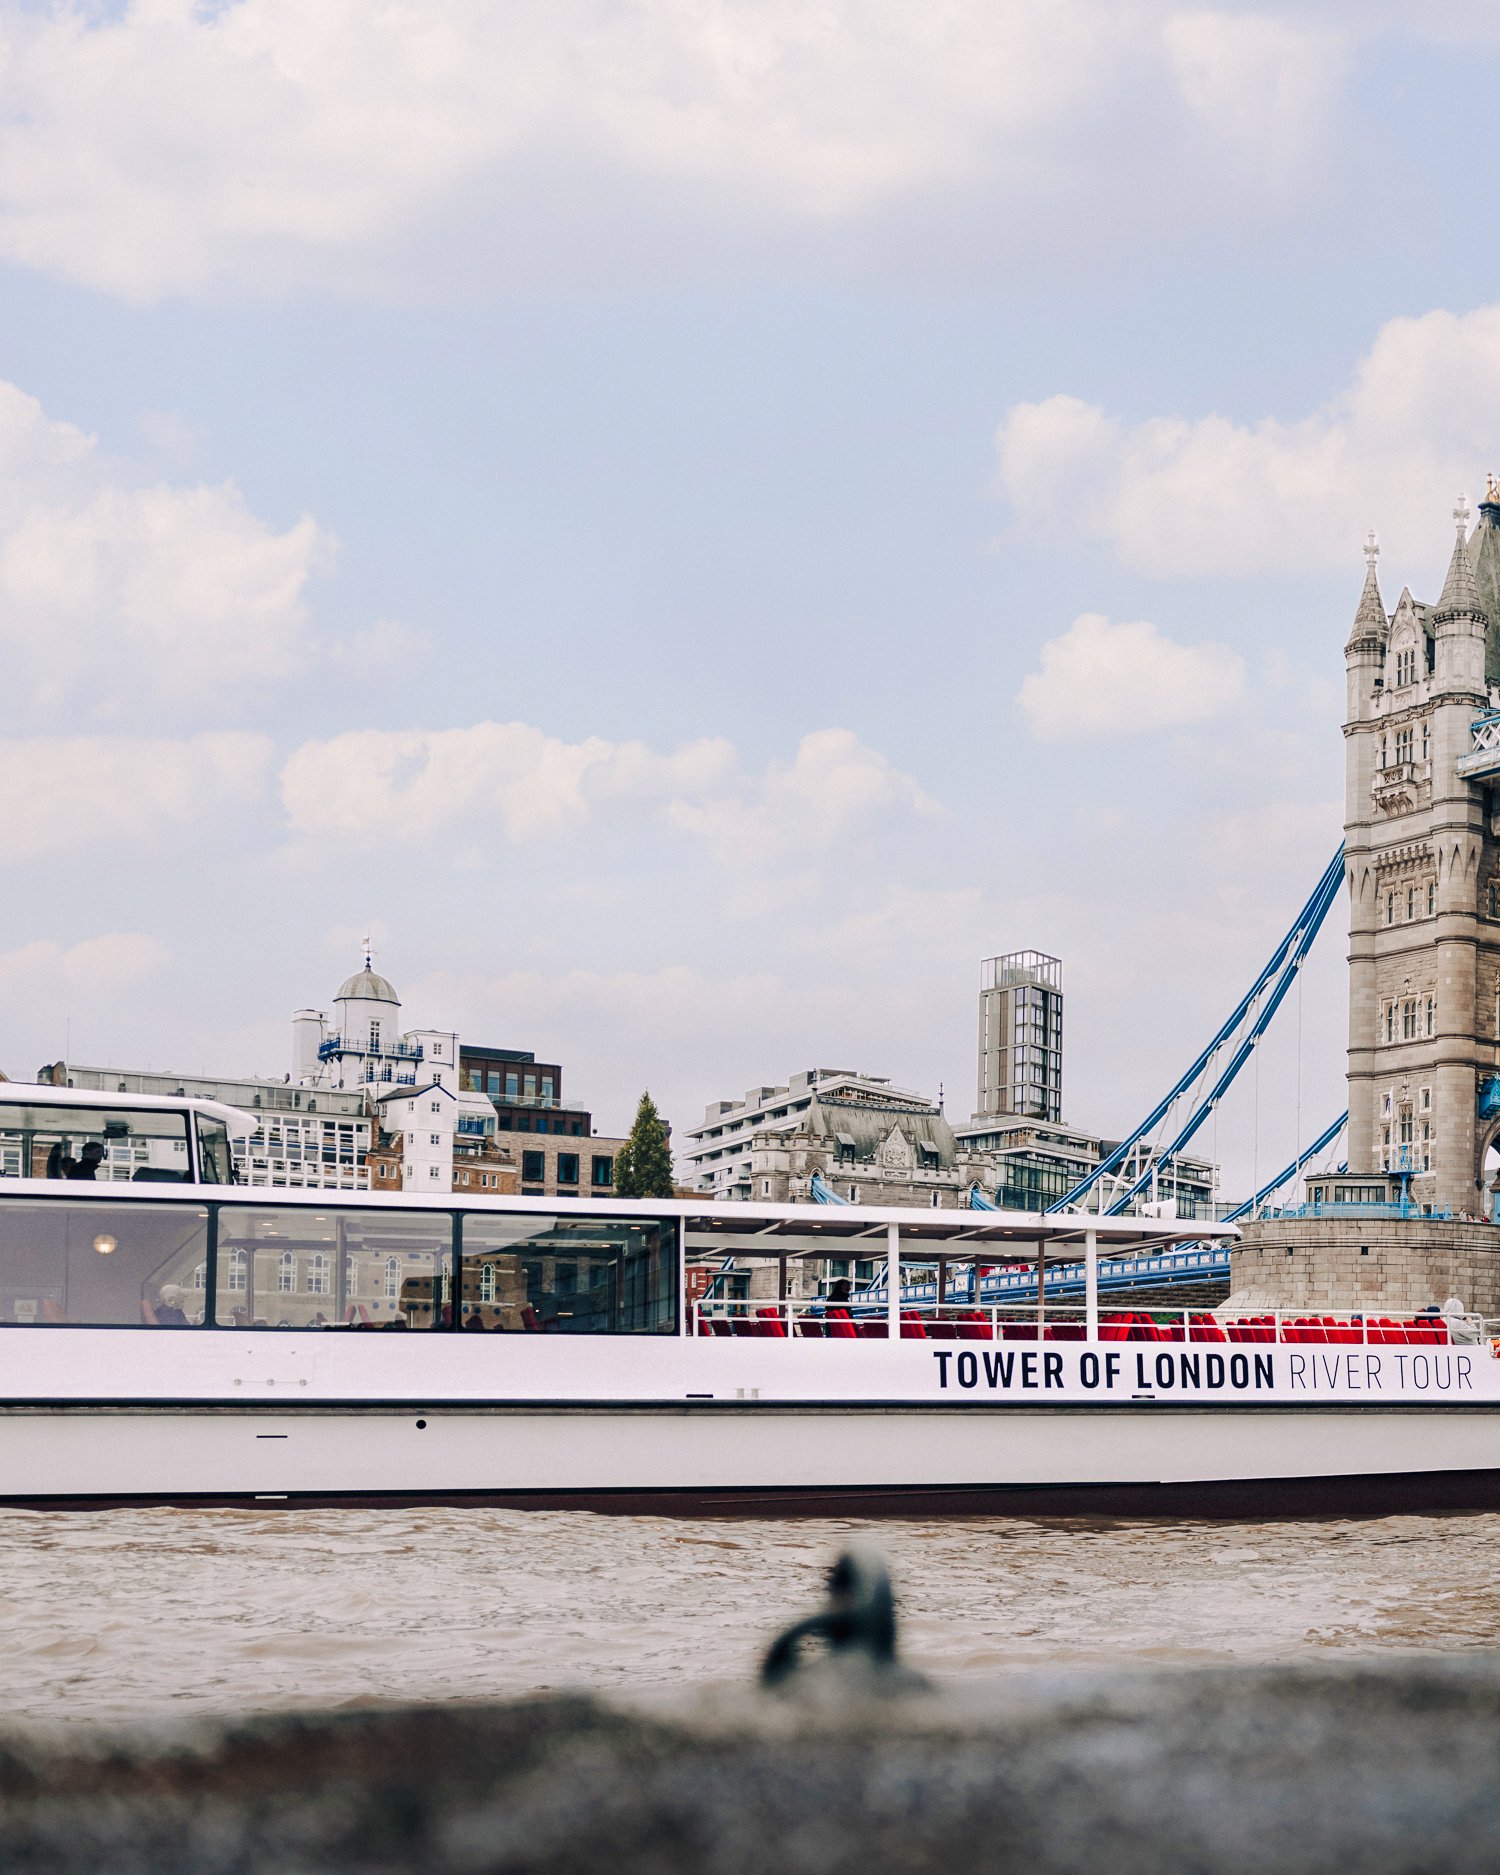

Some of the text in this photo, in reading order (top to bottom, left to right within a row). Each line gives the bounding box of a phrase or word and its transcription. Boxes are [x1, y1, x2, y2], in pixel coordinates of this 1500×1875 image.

[934, 1352, 1473, 1389] TOWER OF LONDON RIVER TOUR
